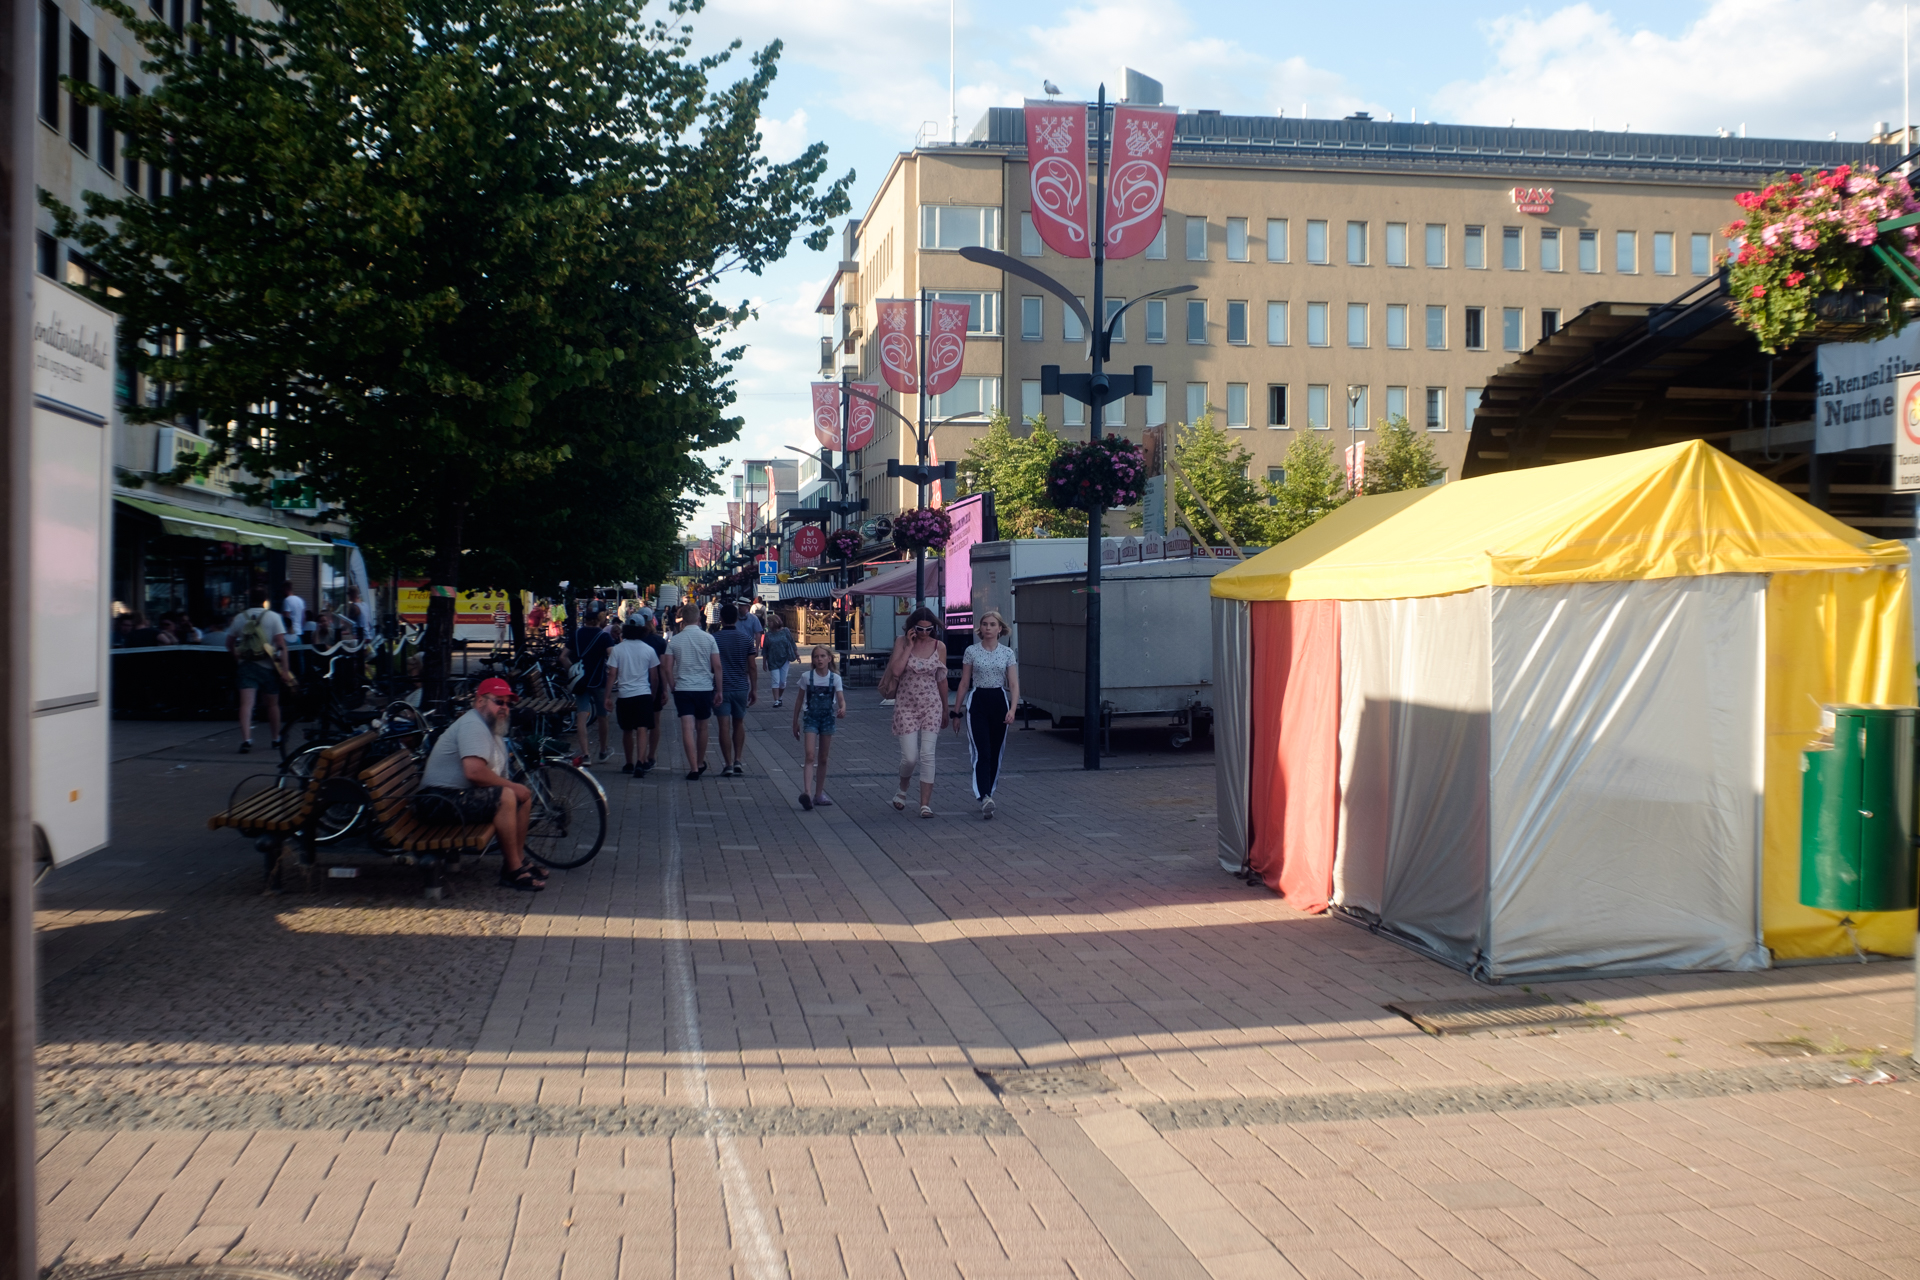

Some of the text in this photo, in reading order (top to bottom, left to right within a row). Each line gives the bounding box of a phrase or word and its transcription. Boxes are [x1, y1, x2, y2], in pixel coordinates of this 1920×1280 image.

[1512, 187, 1554, 204] RAX
[35, 310, 106, 370] onditoriaherkut
[1898, 454, 1920, 466] Toria
